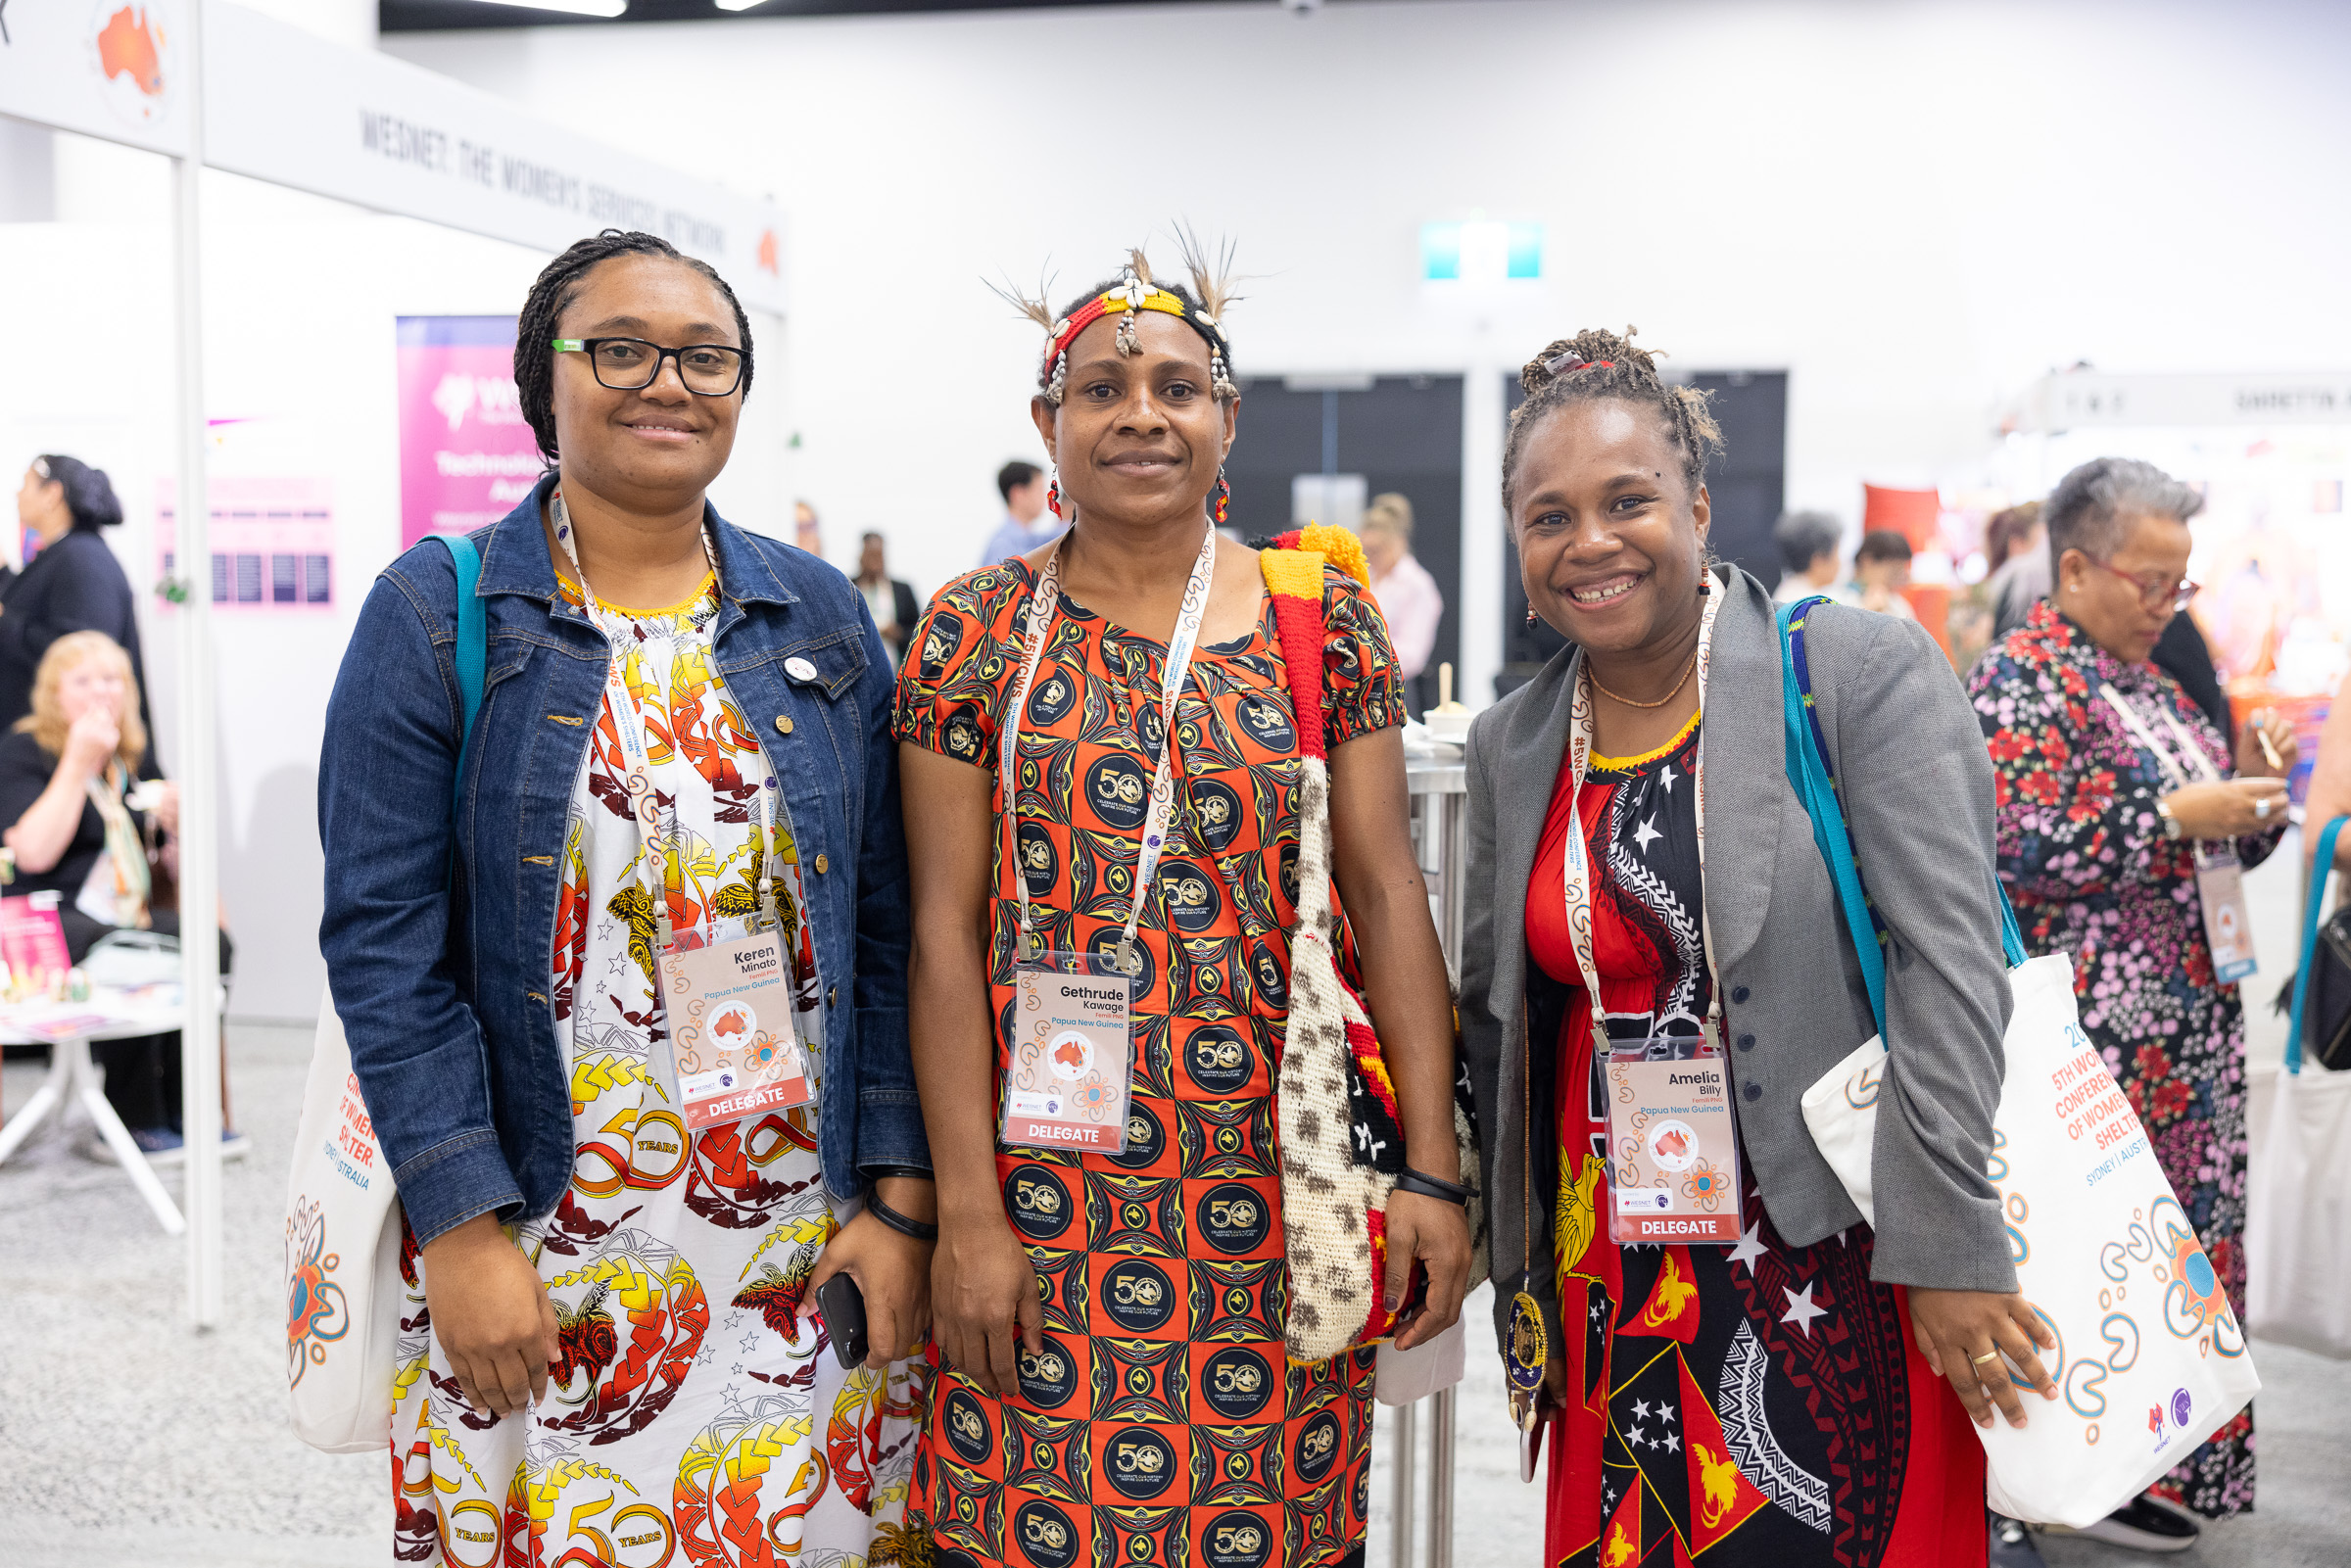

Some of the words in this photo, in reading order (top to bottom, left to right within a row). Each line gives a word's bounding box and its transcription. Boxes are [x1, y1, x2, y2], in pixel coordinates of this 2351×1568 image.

[459, 140, 495, 188] THE
[1011, 633, 1038, 698] #5WCWS
[623, 701, 633, 720] WORLD
[628, 721, 643, 758] CONFERENCE
[624, 725, 634, 752] SHELTERS
[1098, 769, 1142, 804] 50
[1144, 854, 1153, 883] WESNET
[1162, 878, 1207, 906] 50
[734, 946, 775, 964] Keren
[741, 959, 777, 974] Minato
[704, 989, 731, 1000] Papua
[733, 984, 750, 994] New
[751, 977, 780, 989] Guinea
[1061, 986, 1124, 1001] Gethrude
[1083, 1001, 1124, 1014] Kawage
[1051, 1018, 1077, 1026] Papua
[2064, 1022, 2086, 1048] 20
[1196, 1041, 1242, 1069] 50
[1669, 1070, 1720, 1085] Amelia
[2051, 1064, 2076, 1091] 5TH
[2072, 1048, 2103, 1076] WOR
[708, 1087, 785, 1117] DELEGATE
[1700, 1085, 1721, 1097] Billy
[2055, 1069, 2116, 1119] CONFEREN
[1641, 1107, 1669, 1116] Papua
[2068, 1117, 2084, 1141] OF
[2082, 1091, 2129, 1129] WOMEN
[637, 1140, 679, 1155] YEARS
[1029, 1124, 1099, 1143] DELEGATE
[2087, 1157, 2116, 1187] SYDNEY
[1016, 1179, 1061, 1213] 50
[1210, 1200, 1258, 1228] 50
[1641, 1220, 1716, 1234] DELEGATE
[1115, 1275, 1163, 1306] 50
[889, 1373, 910, 1386] YEA
[1020, 1349, 1065, 1383] 50
[1215, 1364, 1261, 1393] 50
[952, 1402, 983, 1440] 50
[1303, 1424, 1334, 1460] 50
[1116, 1444, 1164, 1473] 50
[455, 1528, 495, 1543] YEARS
[618, 1531, 661, 1547] YEARS
[1025, 1513, 1067, 1548] 50
[1215, 1526, 1261, 1553] 50
